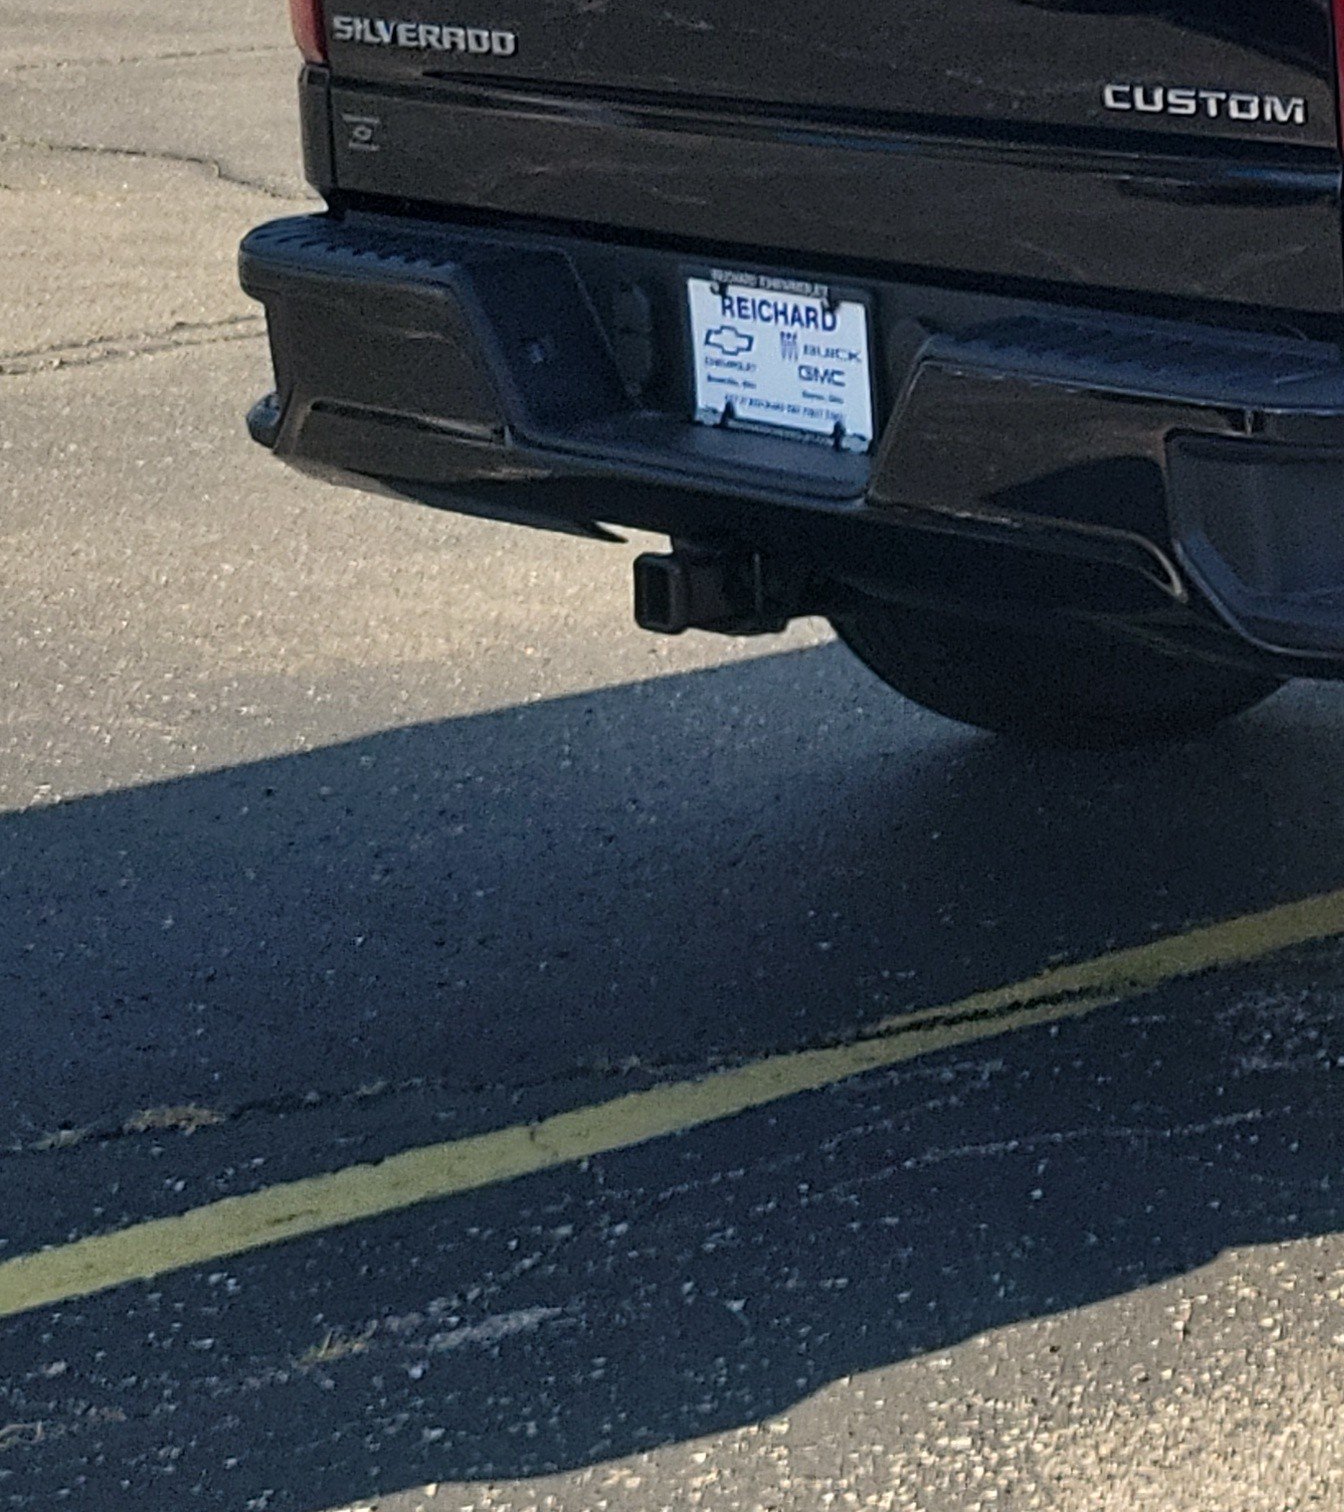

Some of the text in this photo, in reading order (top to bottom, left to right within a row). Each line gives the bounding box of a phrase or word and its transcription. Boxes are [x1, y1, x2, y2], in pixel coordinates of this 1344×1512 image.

[333, 15, 517, 57] SILVERADO
[1103, 84, 1306, 124] CUSTOM
[721, 295, 838, 332] REICHARD
[803, 344, 862, 363] BUICK
[798, 364, 846, 387] GMC
